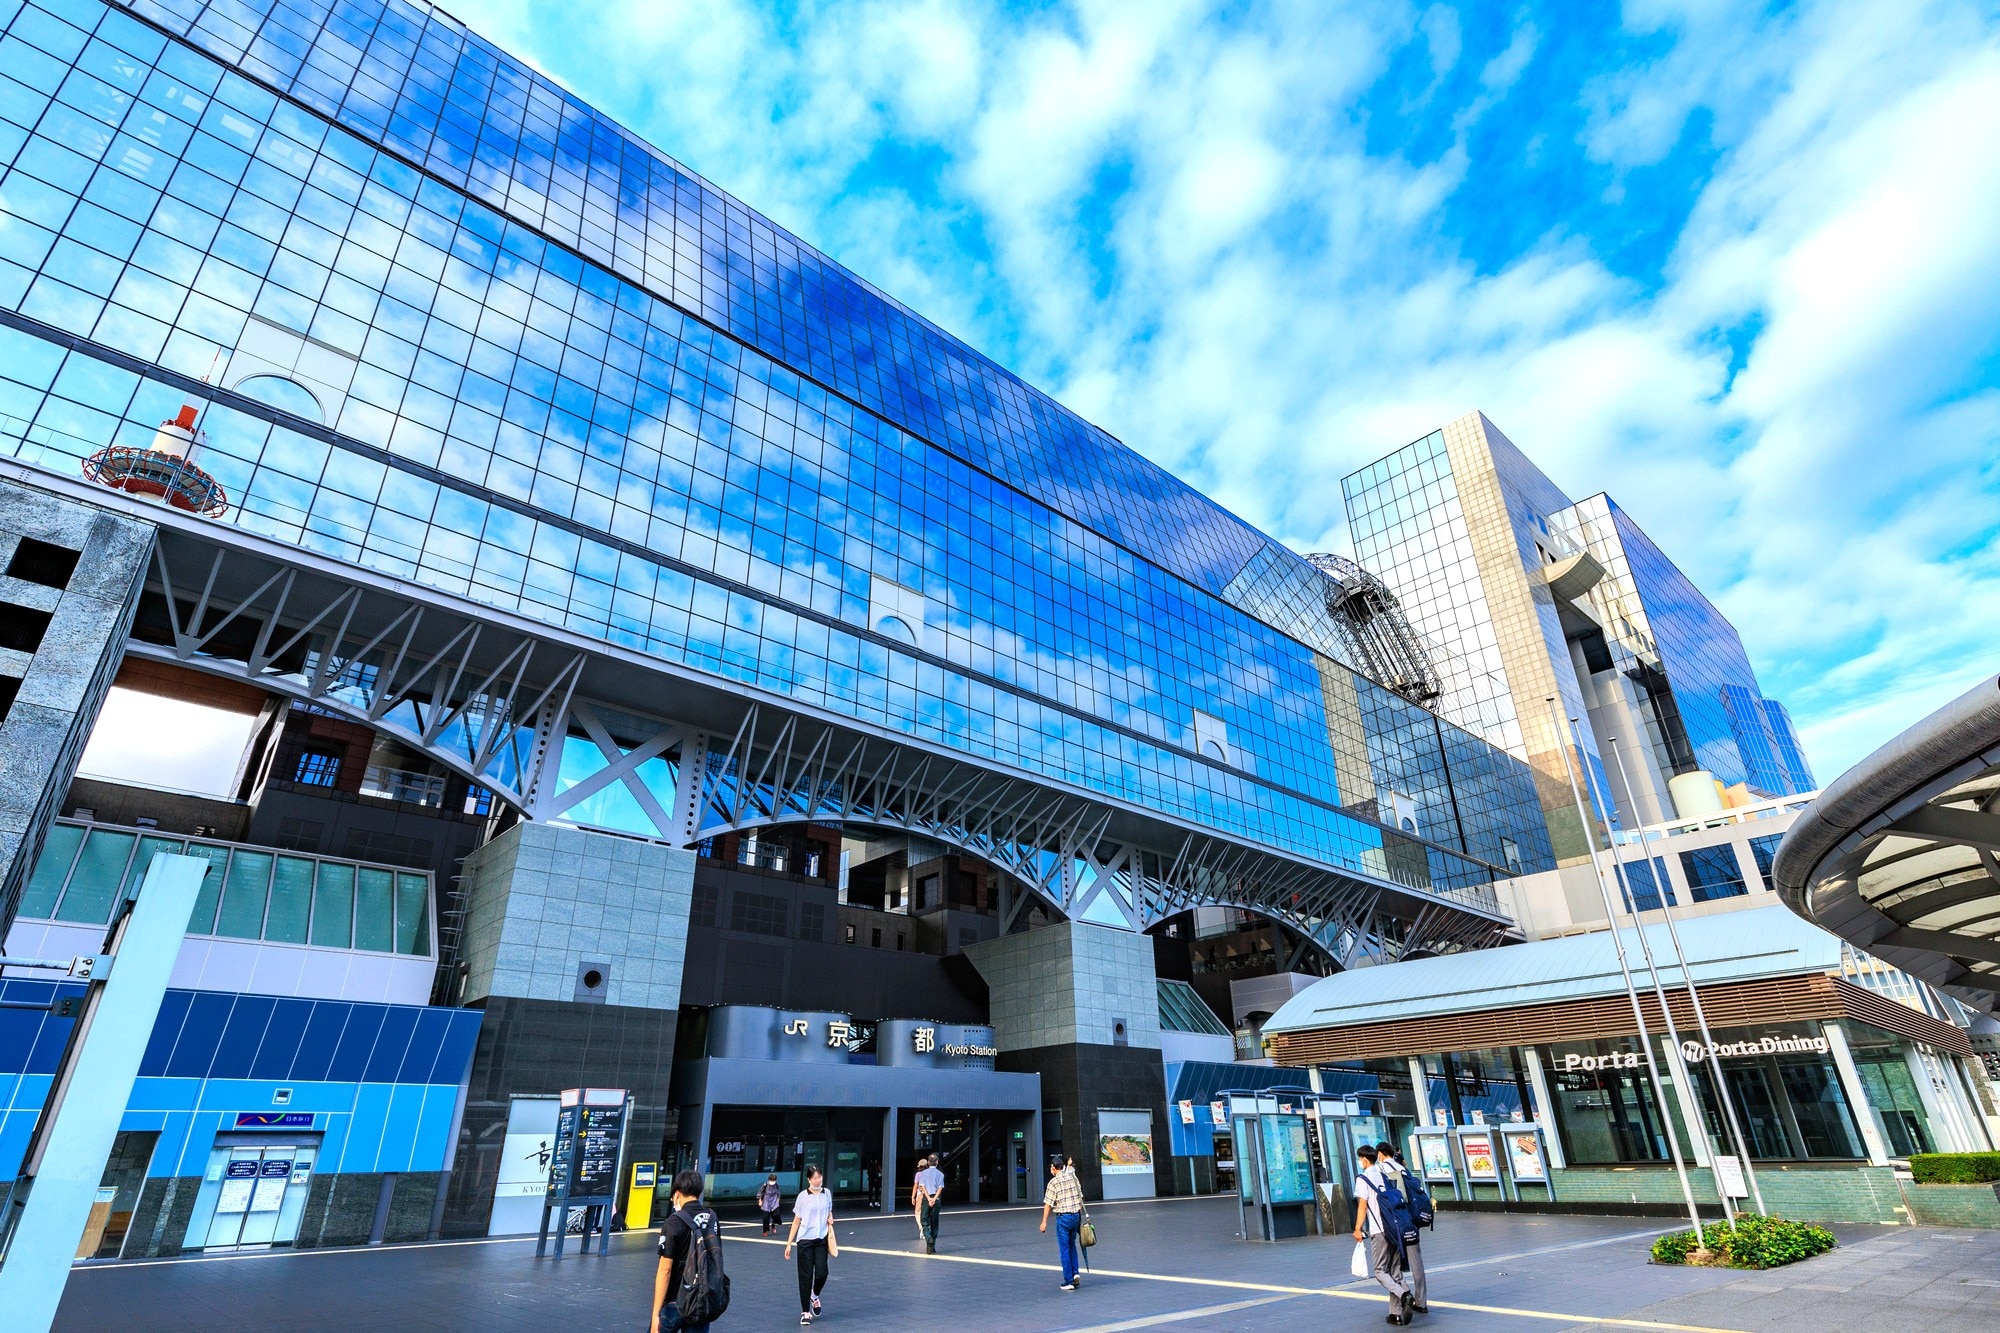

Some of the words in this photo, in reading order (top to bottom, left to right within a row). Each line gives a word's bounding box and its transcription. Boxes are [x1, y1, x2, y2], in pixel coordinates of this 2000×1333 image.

[785, 1020, 808, 1036] JR
[945, 1043, 969, 1057] Kyoto
[970, 1045, 998, 1056] Station
[1760, 1034, 1827, 1054] Dining
[1565, 1051, 1638, 1072] Porta
[523, 1185, 547, 1193] KYOT
